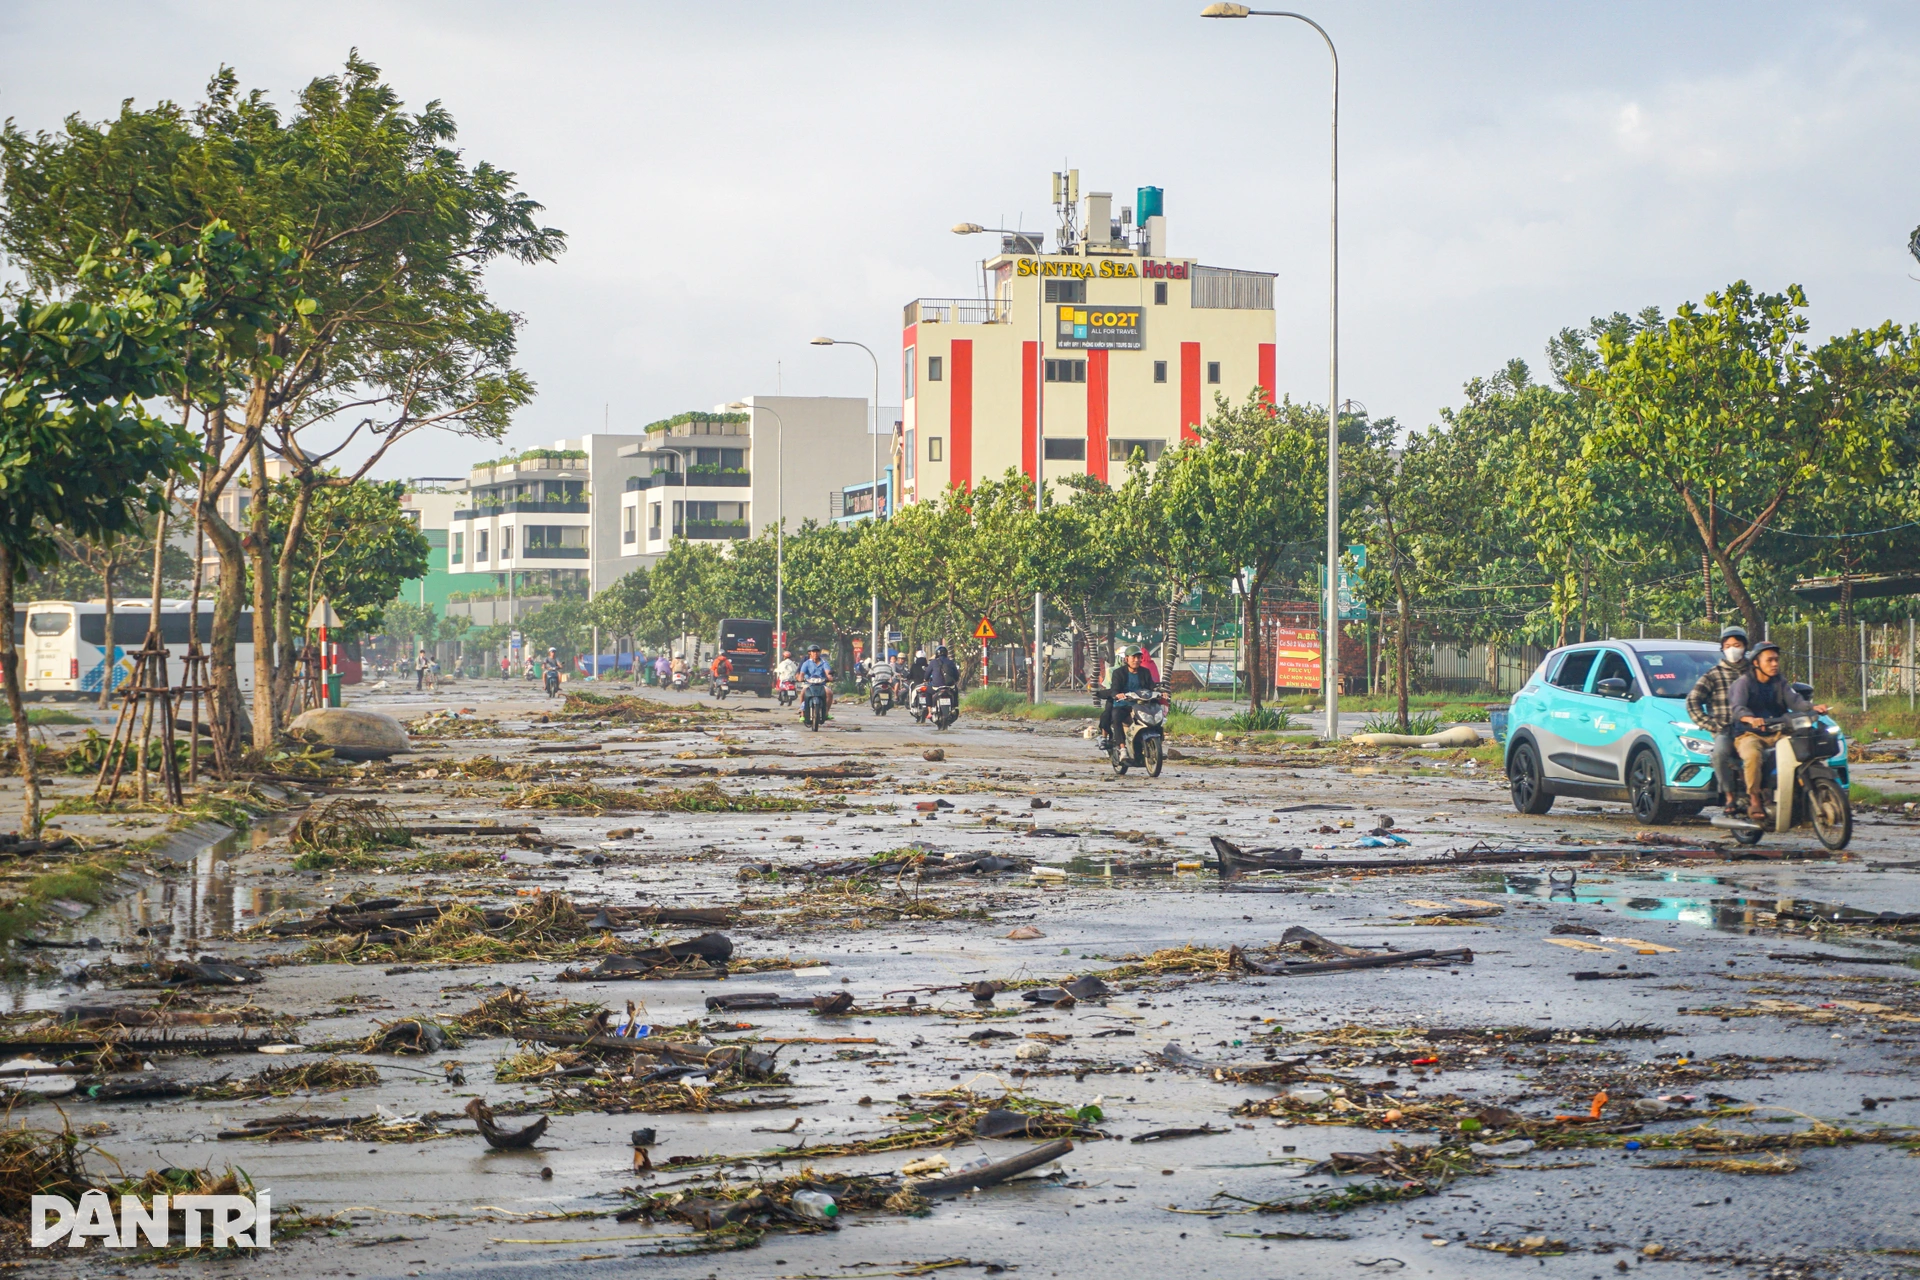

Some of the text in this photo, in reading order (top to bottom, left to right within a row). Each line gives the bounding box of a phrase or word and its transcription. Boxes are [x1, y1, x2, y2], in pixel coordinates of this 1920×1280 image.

[1017, 258, 1188, 279] SONTRA SEA Hotel
[1090, 312, 1139, 327] GO2T
